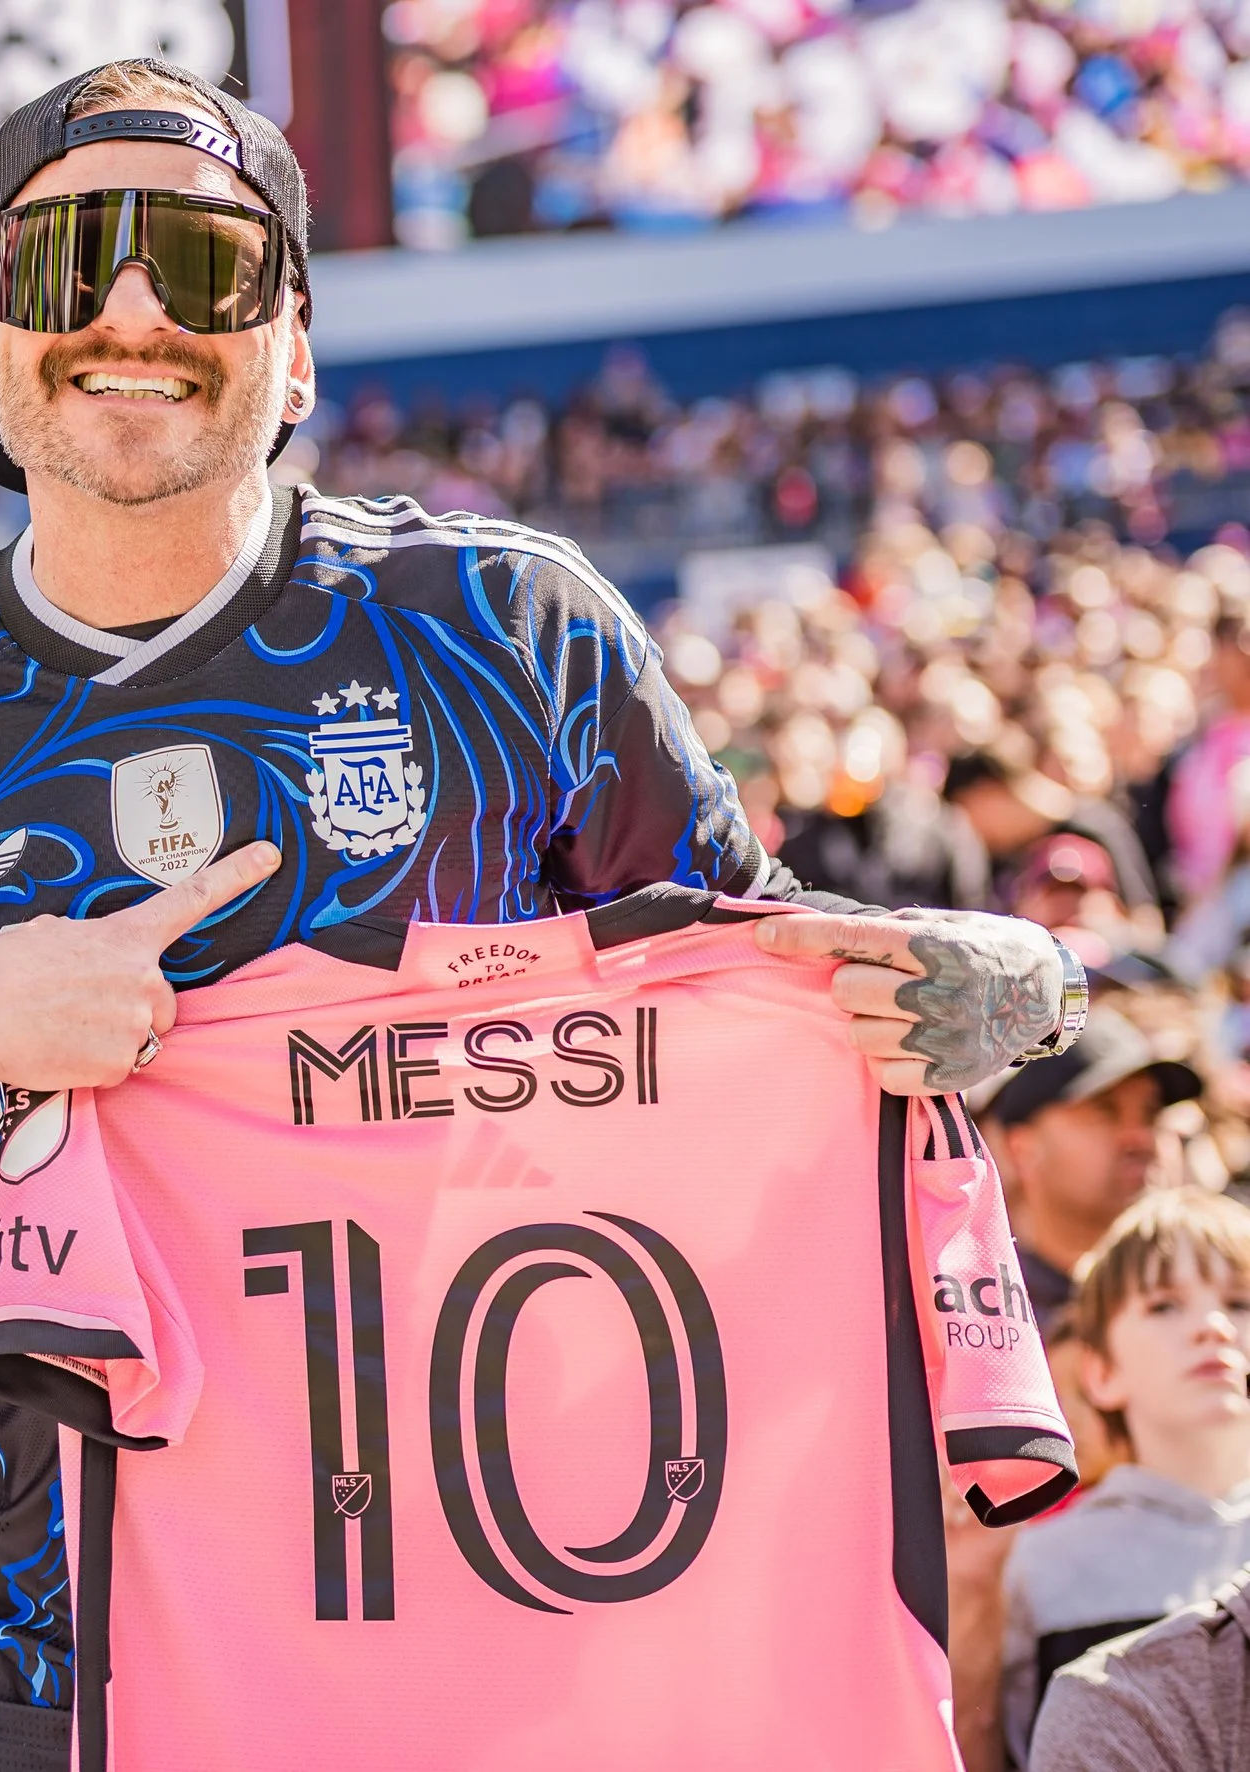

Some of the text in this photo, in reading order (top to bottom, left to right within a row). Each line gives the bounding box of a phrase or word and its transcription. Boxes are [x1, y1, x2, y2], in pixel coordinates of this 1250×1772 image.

[334, 757, 400, 816] AFA
[138, 846, 209, 865] WORLD CHAMPIONS
[148, 832, 197, 856] FIFA
[160, 858, 189, 872] 2022
[447, 944, 541, 973] FREEDOM
[485, 963, 505, 973] TO
[458, 968, 526, 988] DREAM
[287, 1007, 659, 1126] MESSI
[5, 1090, 31, 1115] LS
[8, 1215, 79, 1276] tv
[933, 1262, 1036, 1330] ach
[946, 1321, 1020, 1351] ROUP
[242, 1210, 728, 1621] 10
[668, 1463, 690, 1472] MLS
[335, 1478, 357, 1487] MLS
